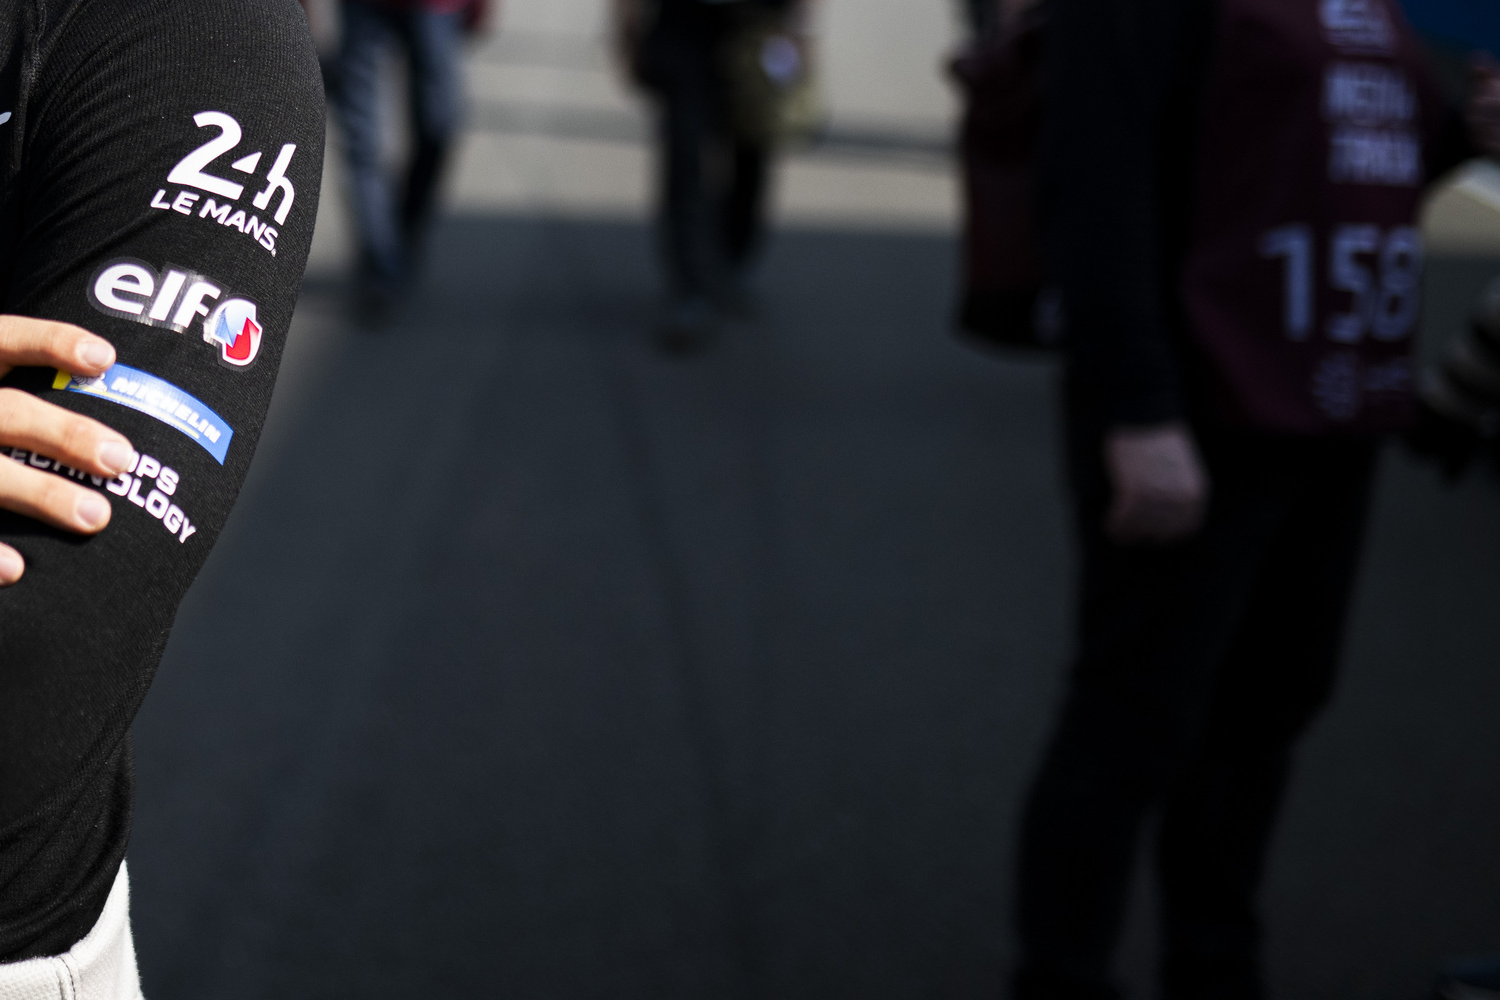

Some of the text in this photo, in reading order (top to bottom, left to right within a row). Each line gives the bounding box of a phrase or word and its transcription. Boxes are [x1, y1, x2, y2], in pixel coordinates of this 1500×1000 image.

[166, 110, 297, 225] 24h
[150, 189, 279, 251] LE MANS
[93, 262, 220, 330] elf
[1257, 224, 1421, 343] 158
[111, 377, 222, 444] MICHELIN
